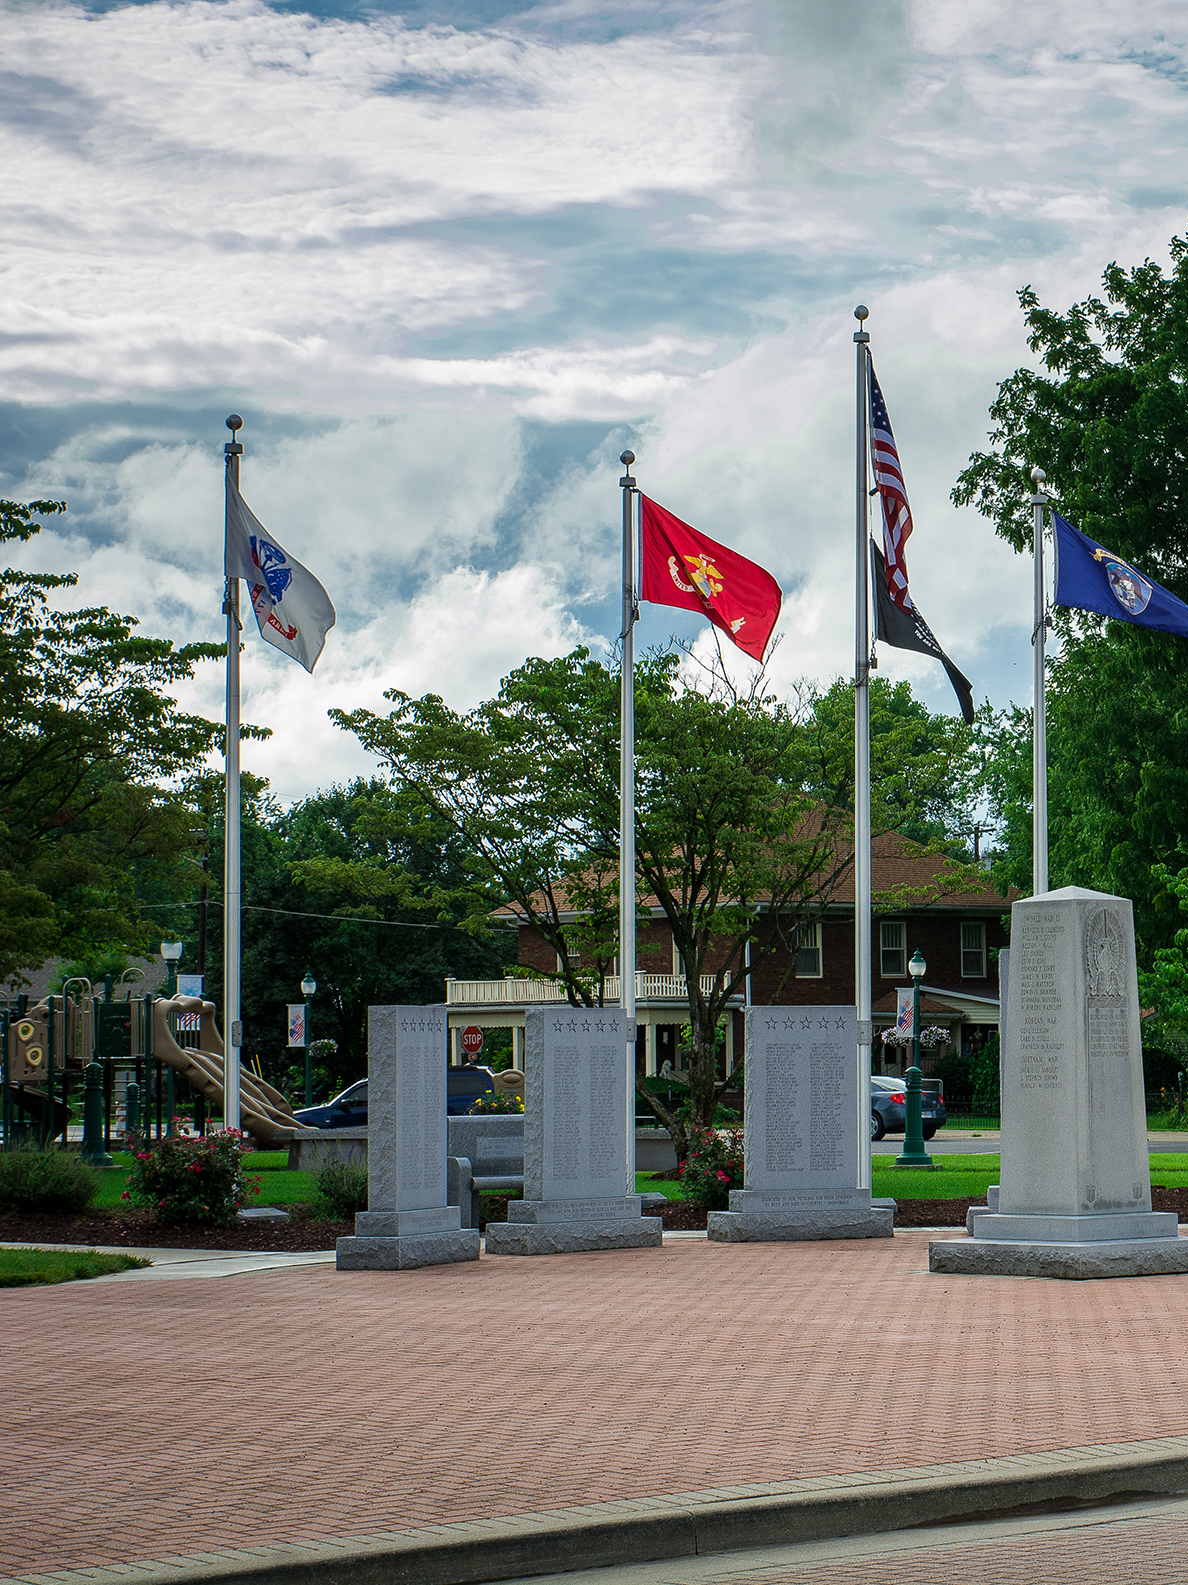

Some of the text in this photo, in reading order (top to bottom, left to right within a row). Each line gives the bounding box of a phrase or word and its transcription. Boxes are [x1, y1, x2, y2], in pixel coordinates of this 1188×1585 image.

[673, 574, 688, 590] UNITED
[914, 630, 924, 639] YOU
[1043, 914, 1054, 922] WAR
[464, 1034, 482, 1044] STOP
